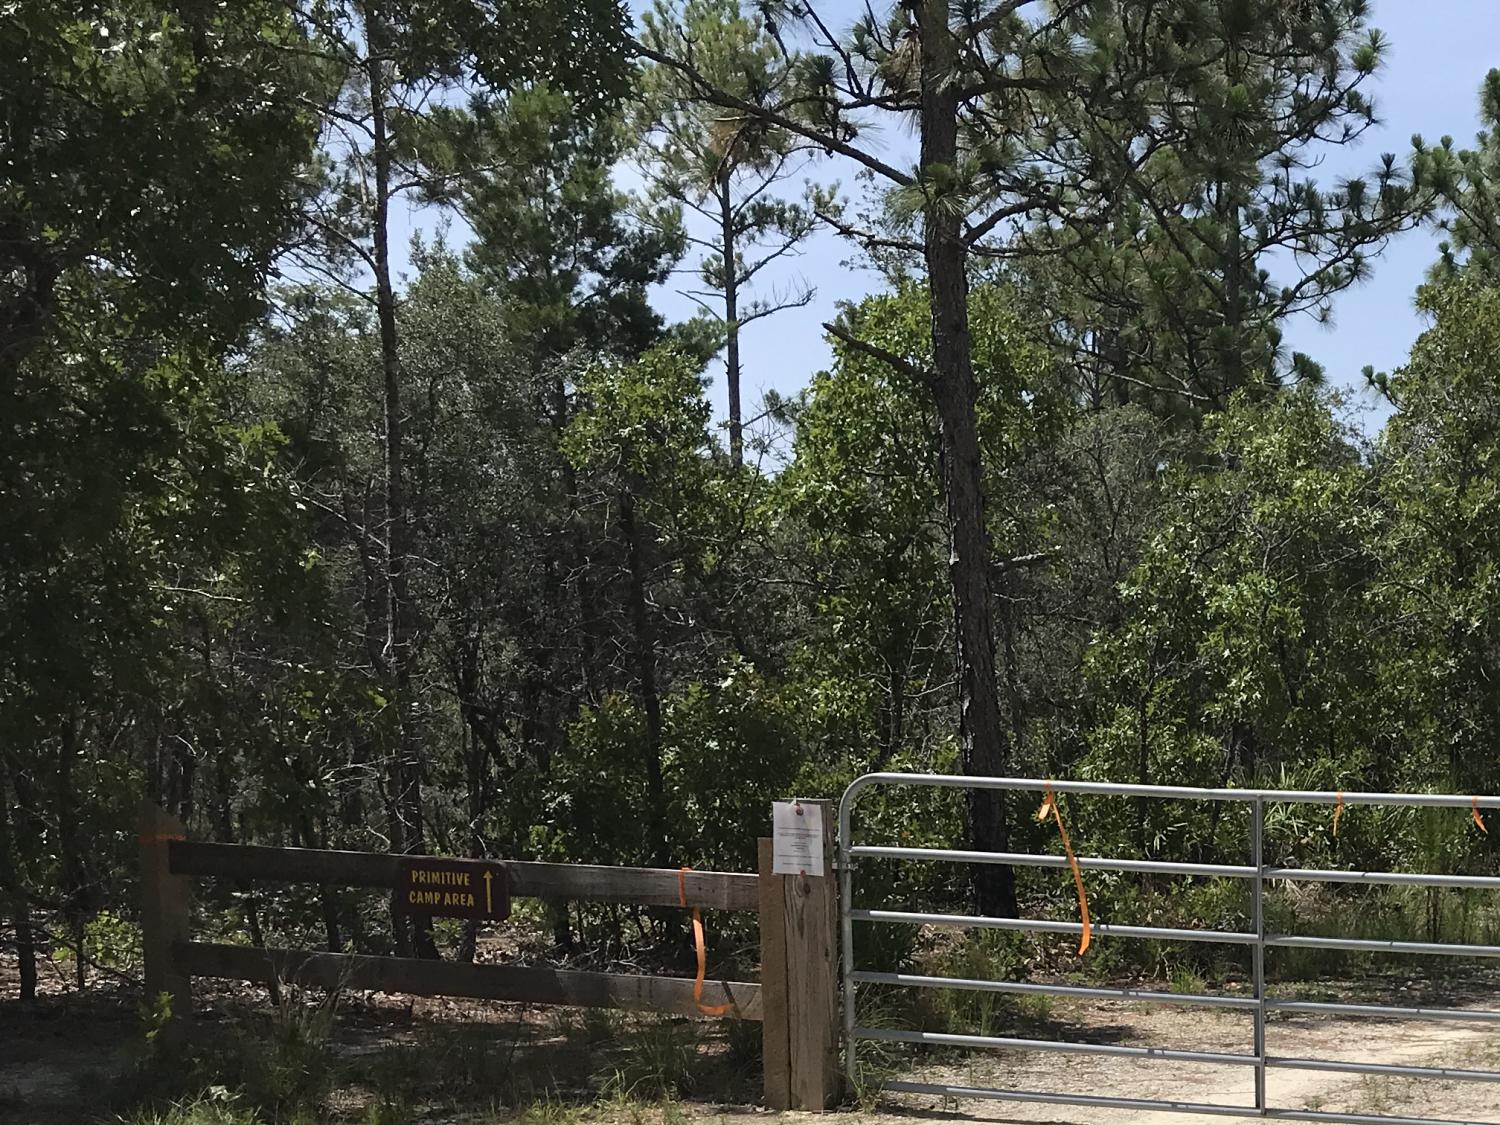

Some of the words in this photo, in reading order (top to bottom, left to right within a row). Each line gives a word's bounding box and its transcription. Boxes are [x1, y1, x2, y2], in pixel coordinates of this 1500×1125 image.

[411, 870, 471, 886] PRIMITIVE
[409, 891, 441, 905] CAMP
[444, 893, 475, 907] AREA
